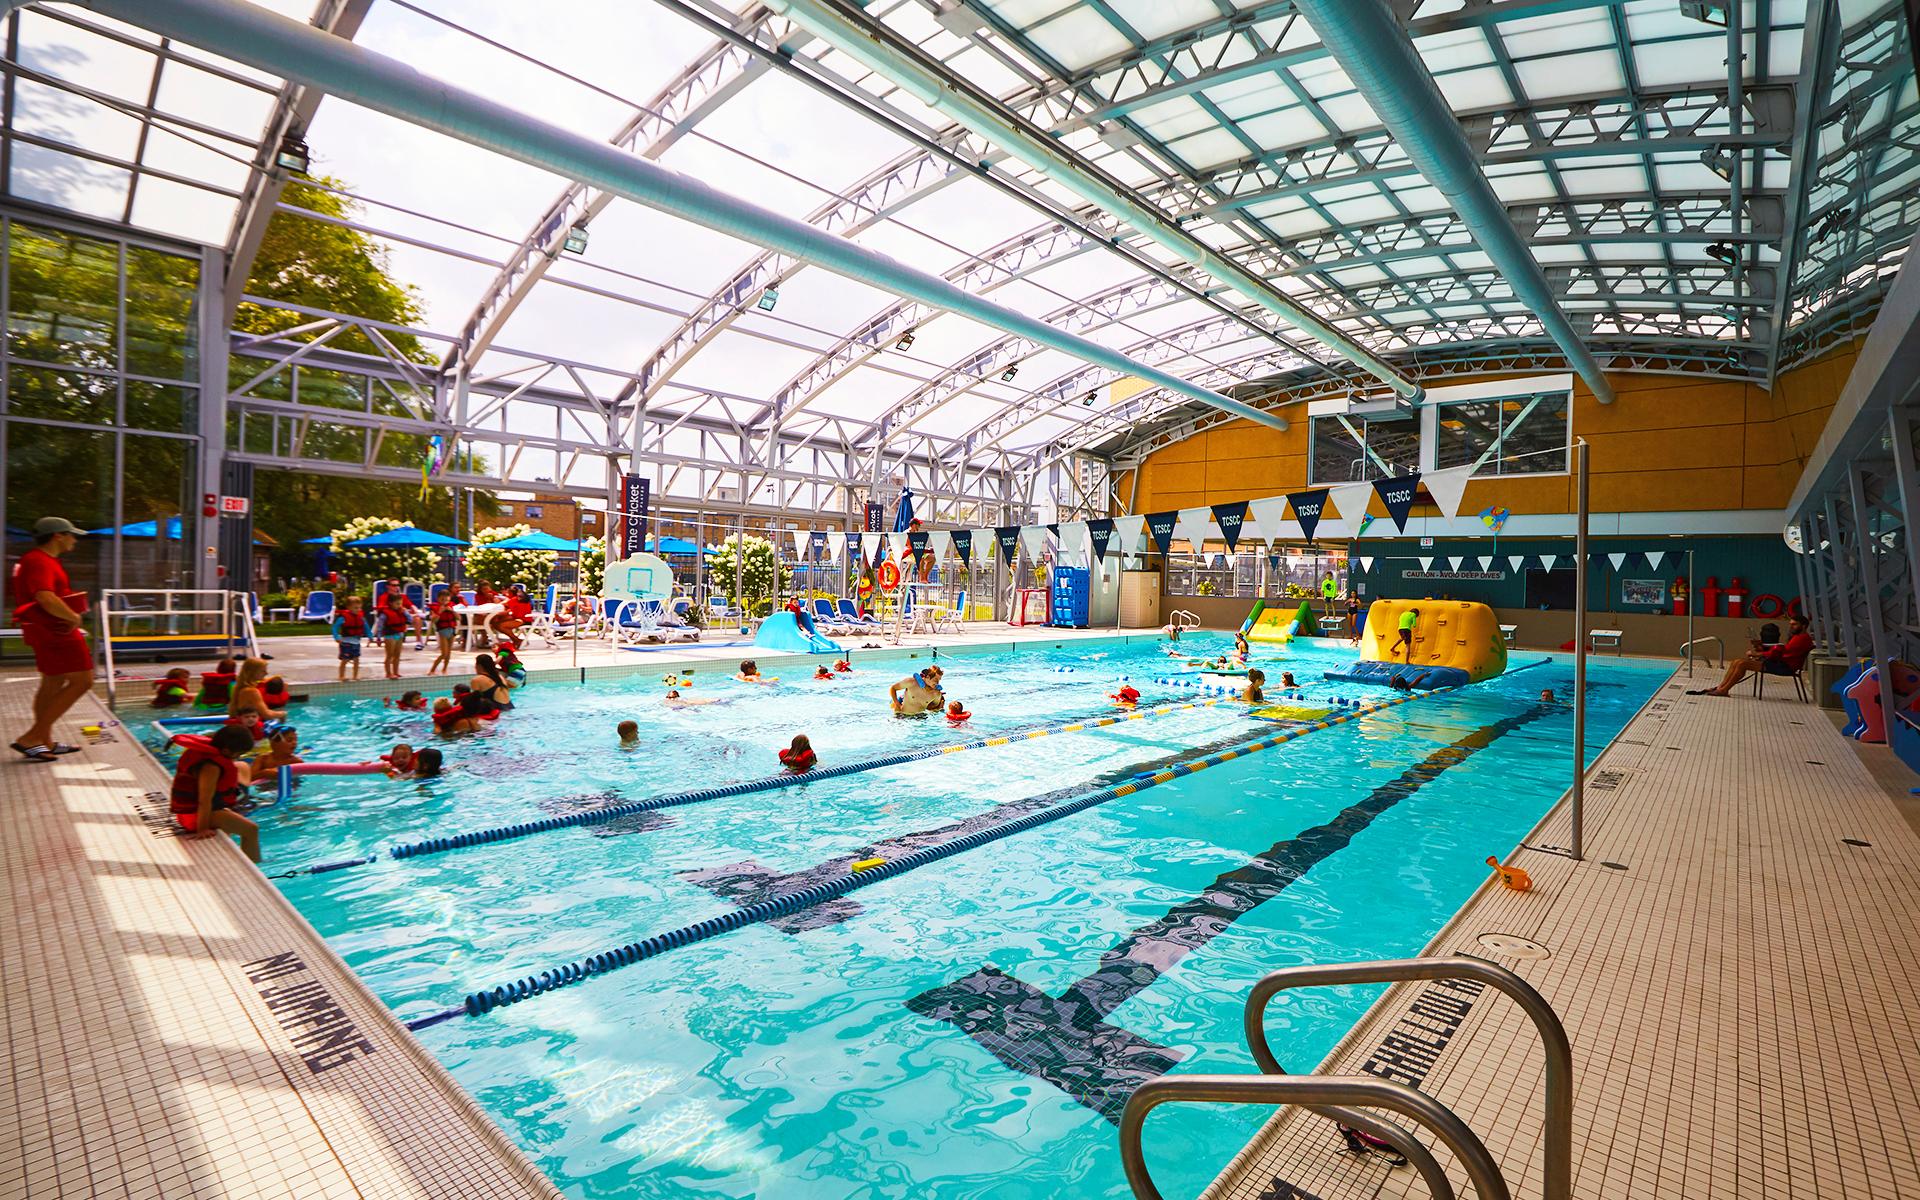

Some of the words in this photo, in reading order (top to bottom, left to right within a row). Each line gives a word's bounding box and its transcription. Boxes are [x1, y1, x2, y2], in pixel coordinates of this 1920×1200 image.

[1387, 490, 1411, 503] TCSCC
[628, 484, 640, 526] Cricket
[1298, 504, 1319, 516] TCSCC
[1222, 515, 1240, 526] TCSCC
[1092, 530, 1108, 540] TCSCC
[1154, 524, 1171, 534] TCSCC
[628, 528, 638, 551] The
[241, 951, 307, 985] NO
[259, 980, 378, 1074] JUMPING
